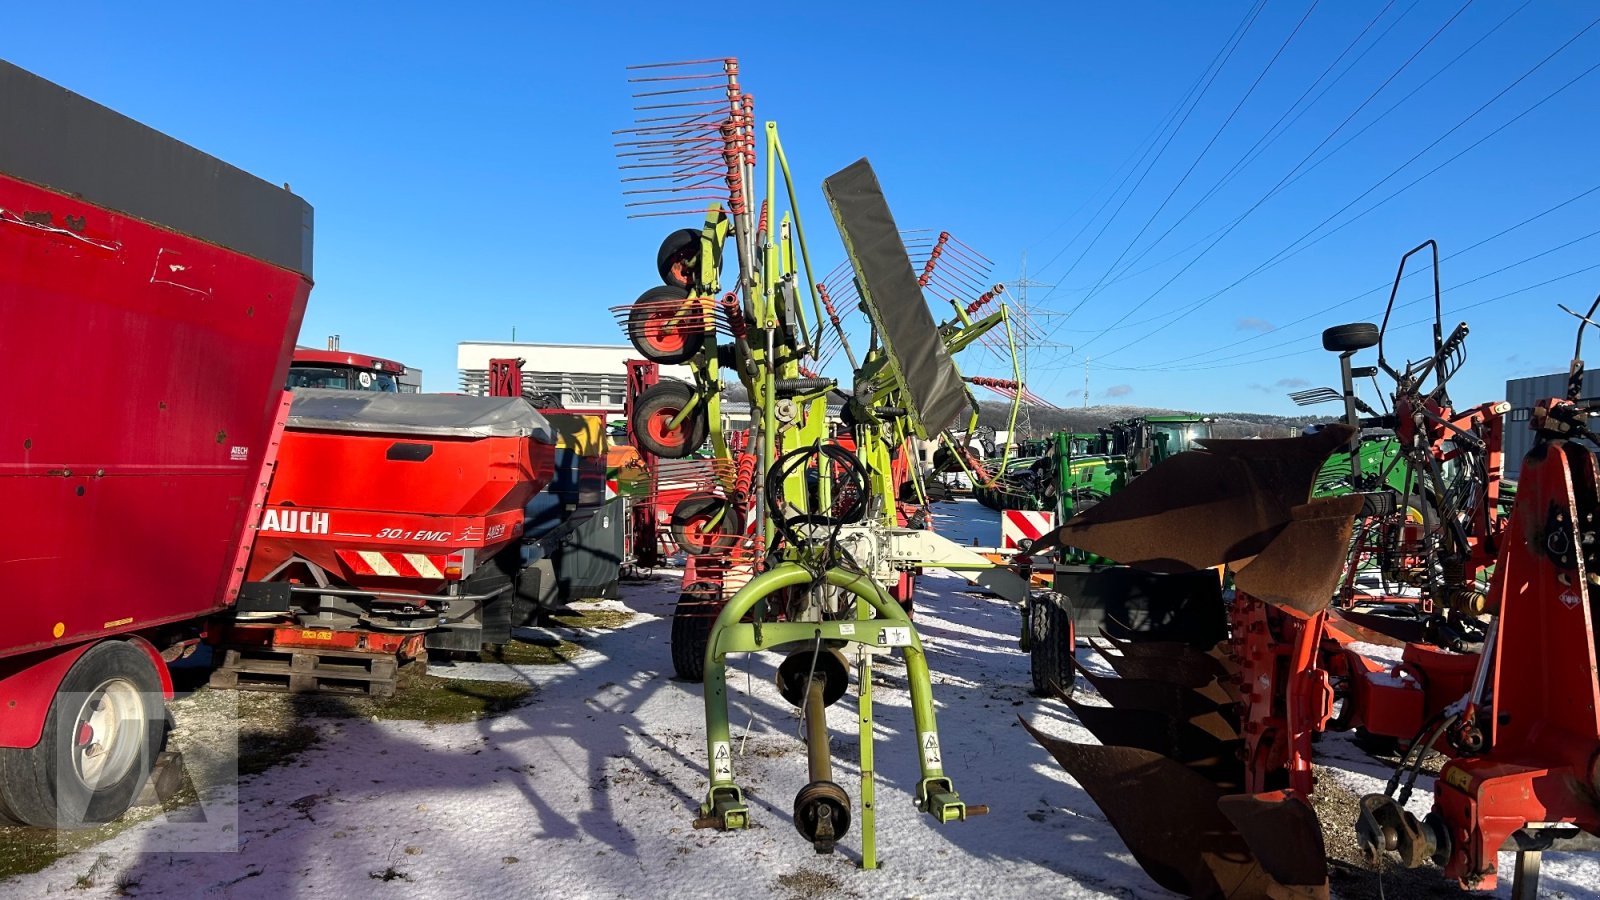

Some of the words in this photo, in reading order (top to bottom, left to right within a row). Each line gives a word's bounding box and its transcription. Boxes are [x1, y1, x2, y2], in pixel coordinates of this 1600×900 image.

[257, 508, 329, 534] AUCH
[376, 528, 412, 539] 30.1
[412, 530, 452, 542] EMC
